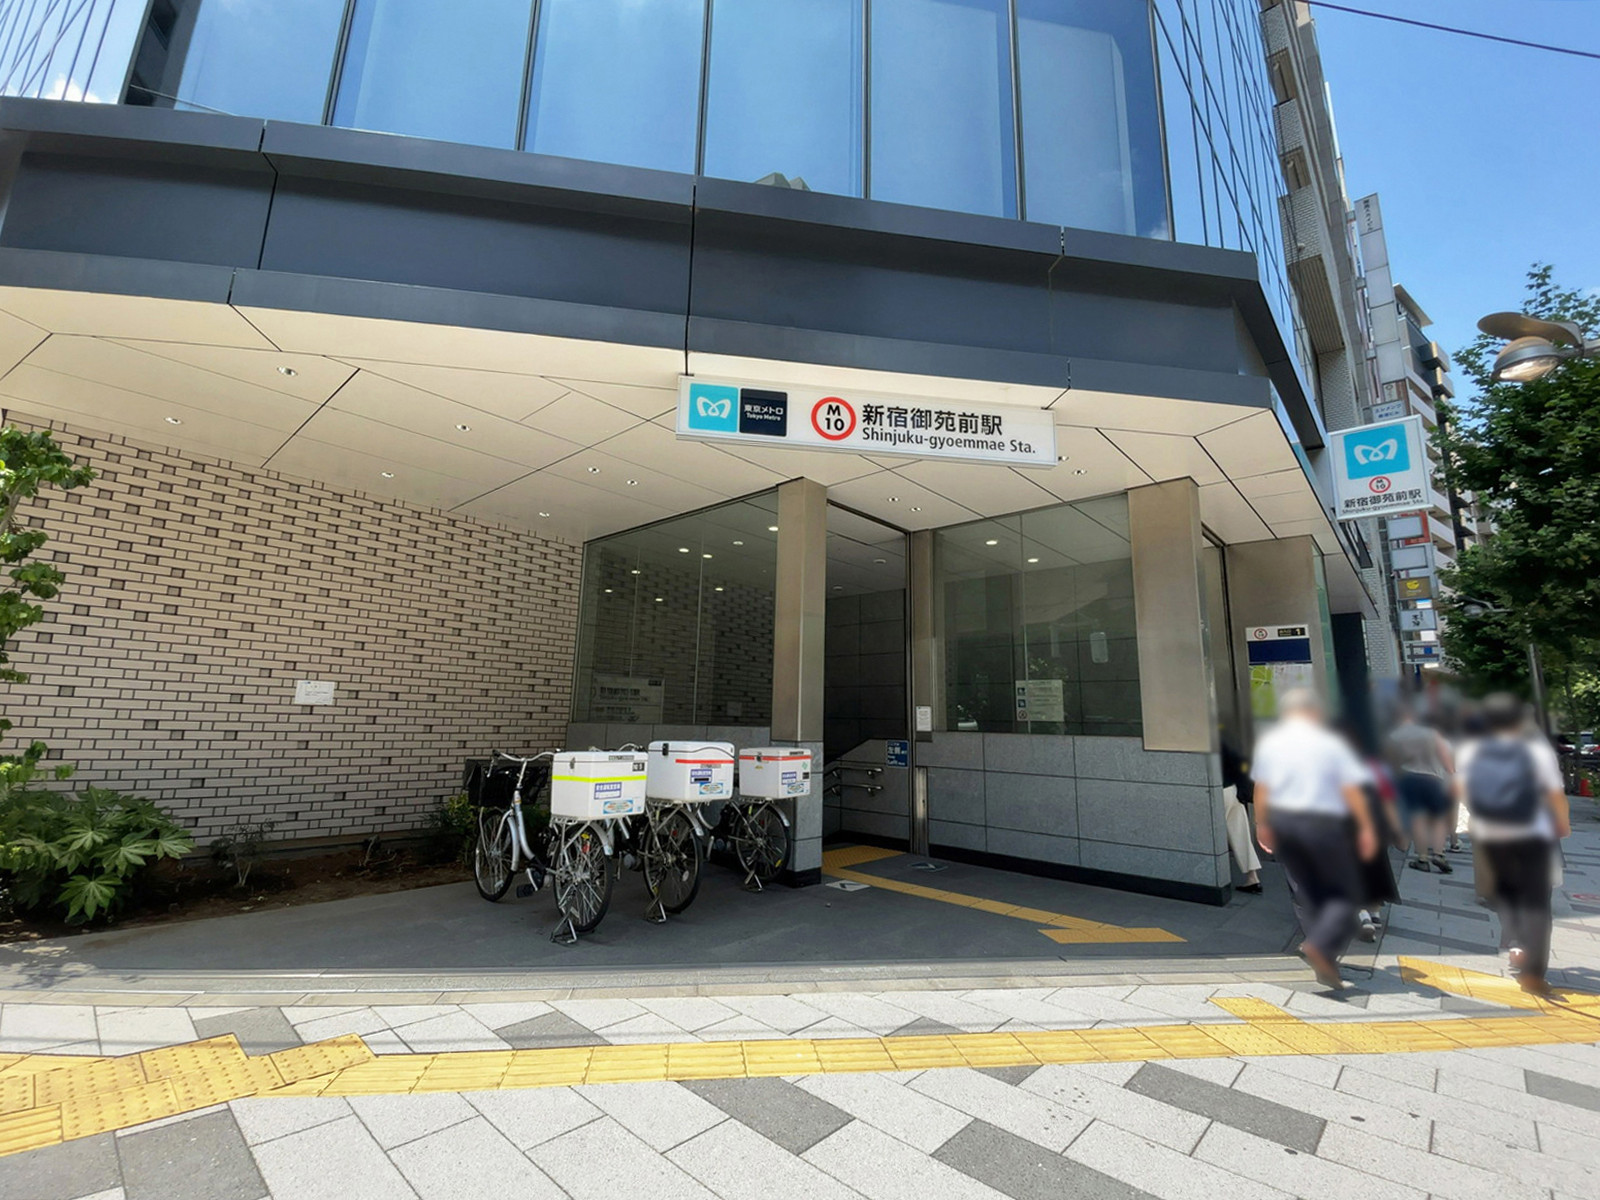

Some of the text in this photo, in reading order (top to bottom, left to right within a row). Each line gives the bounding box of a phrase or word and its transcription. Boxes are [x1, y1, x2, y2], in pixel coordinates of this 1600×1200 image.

[744, 404, 784, 415] 東京メトロ
[746, 412, 763, 420] Tokyo
[826, 404, 841, 417] M
[825, 417, 845, 431] 10
[862, 403, 1002, 436] 新宿御苑前駅
[862, 427, 1036, 454] Shinjuku-gyoemmae Sta.
[1344, 488, 1422, 508] 新宿御苑前駅
